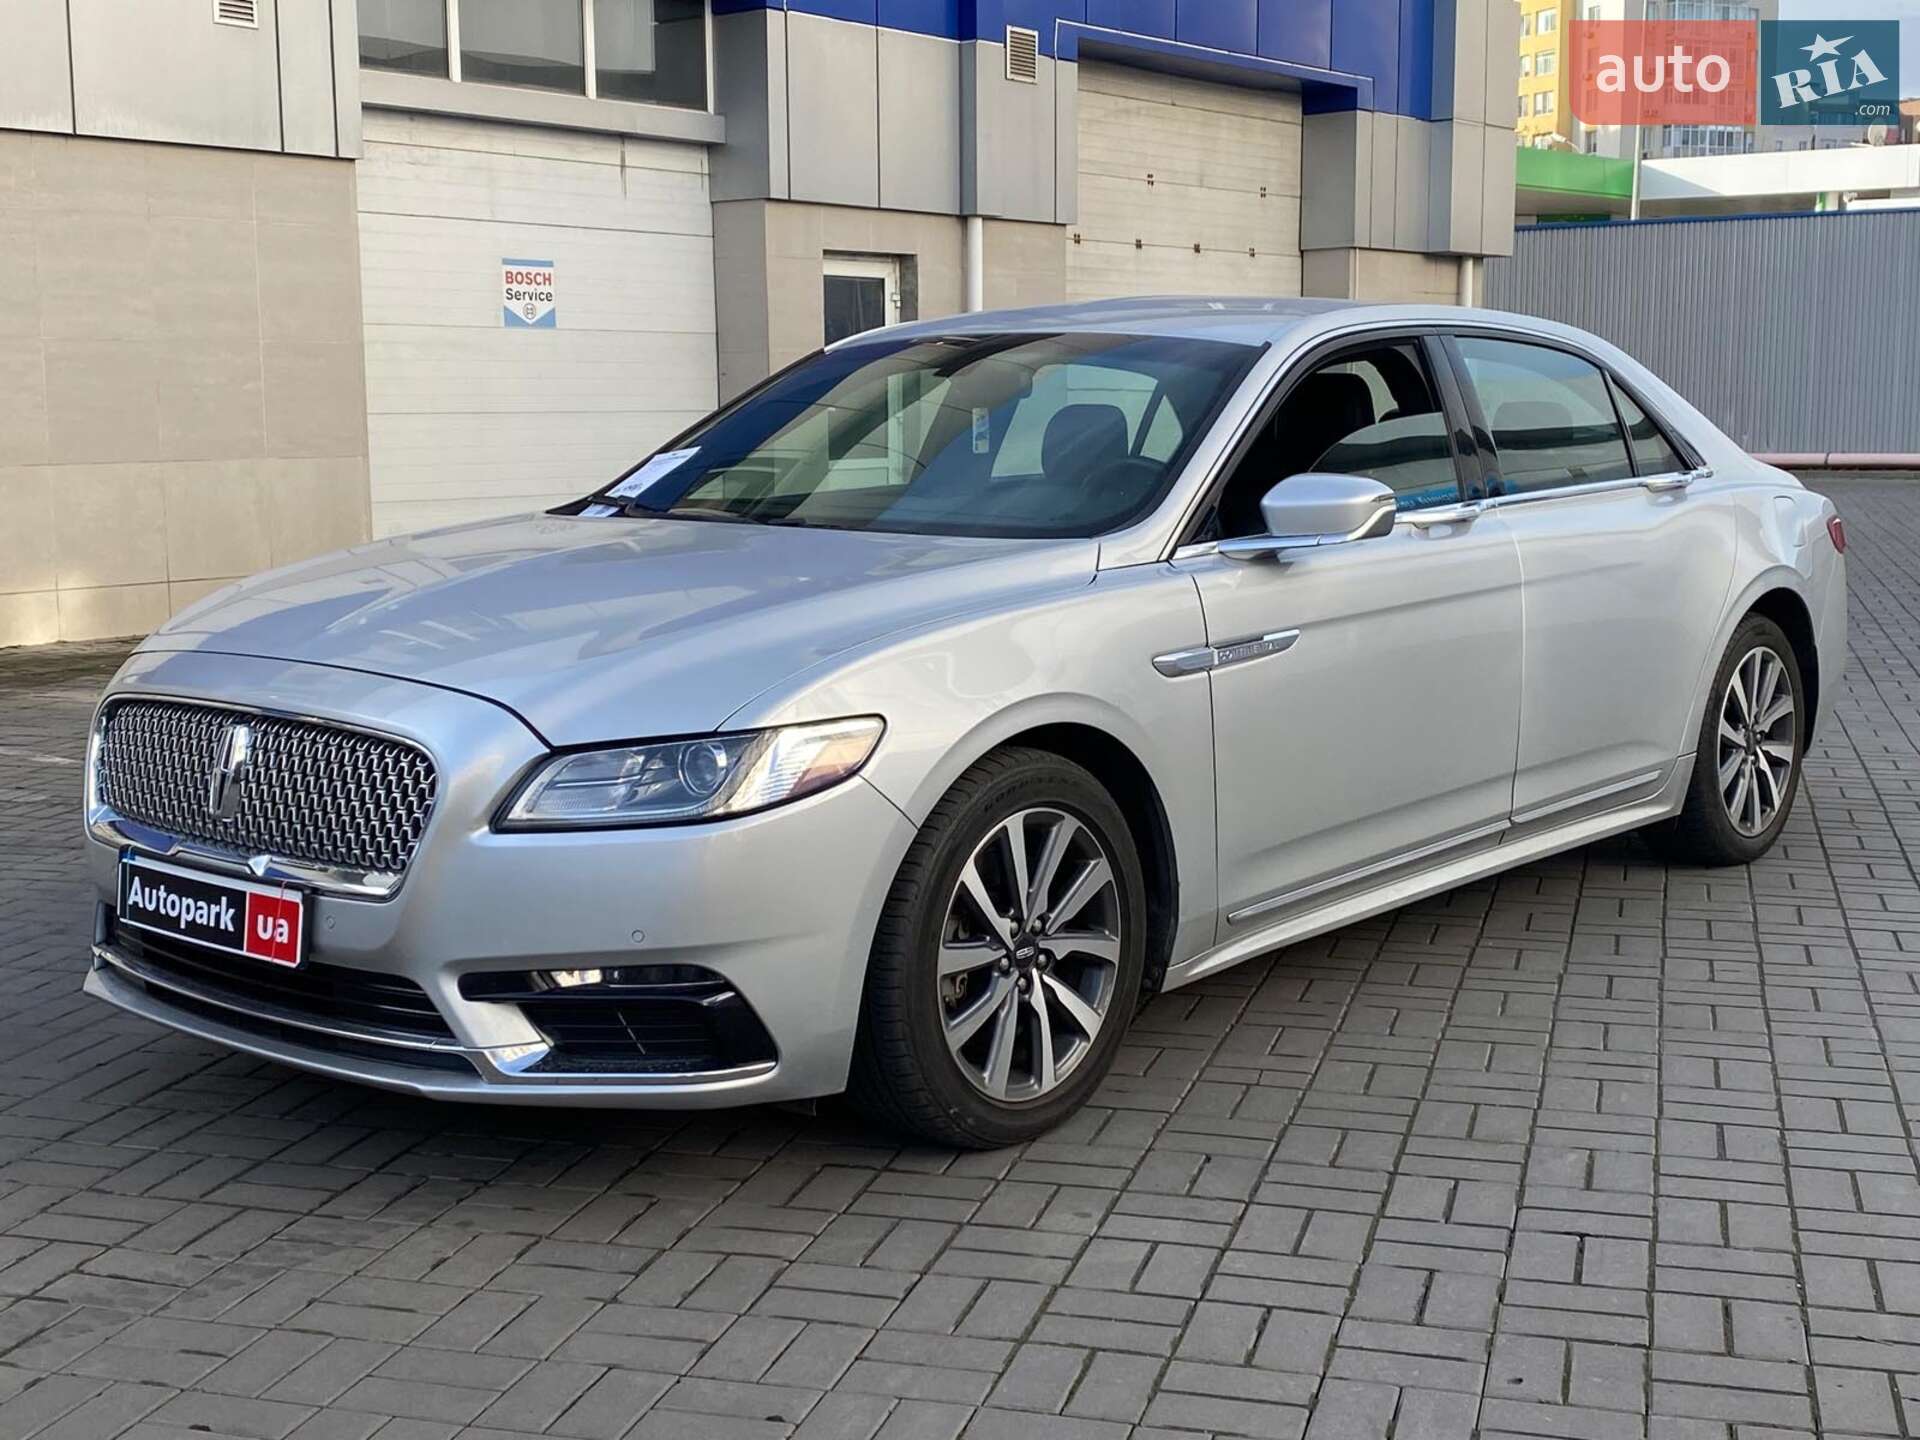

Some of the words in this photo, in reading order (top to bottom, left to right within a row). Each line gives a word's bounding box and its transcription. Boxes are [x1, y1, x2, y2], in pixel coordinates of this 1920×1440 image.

[504, 270, 553, 287] BOSCH
[504, 287, 554, 302] Service
[128, 876, 235, 931] Autopark
[256, 913, 289, 944] ua
